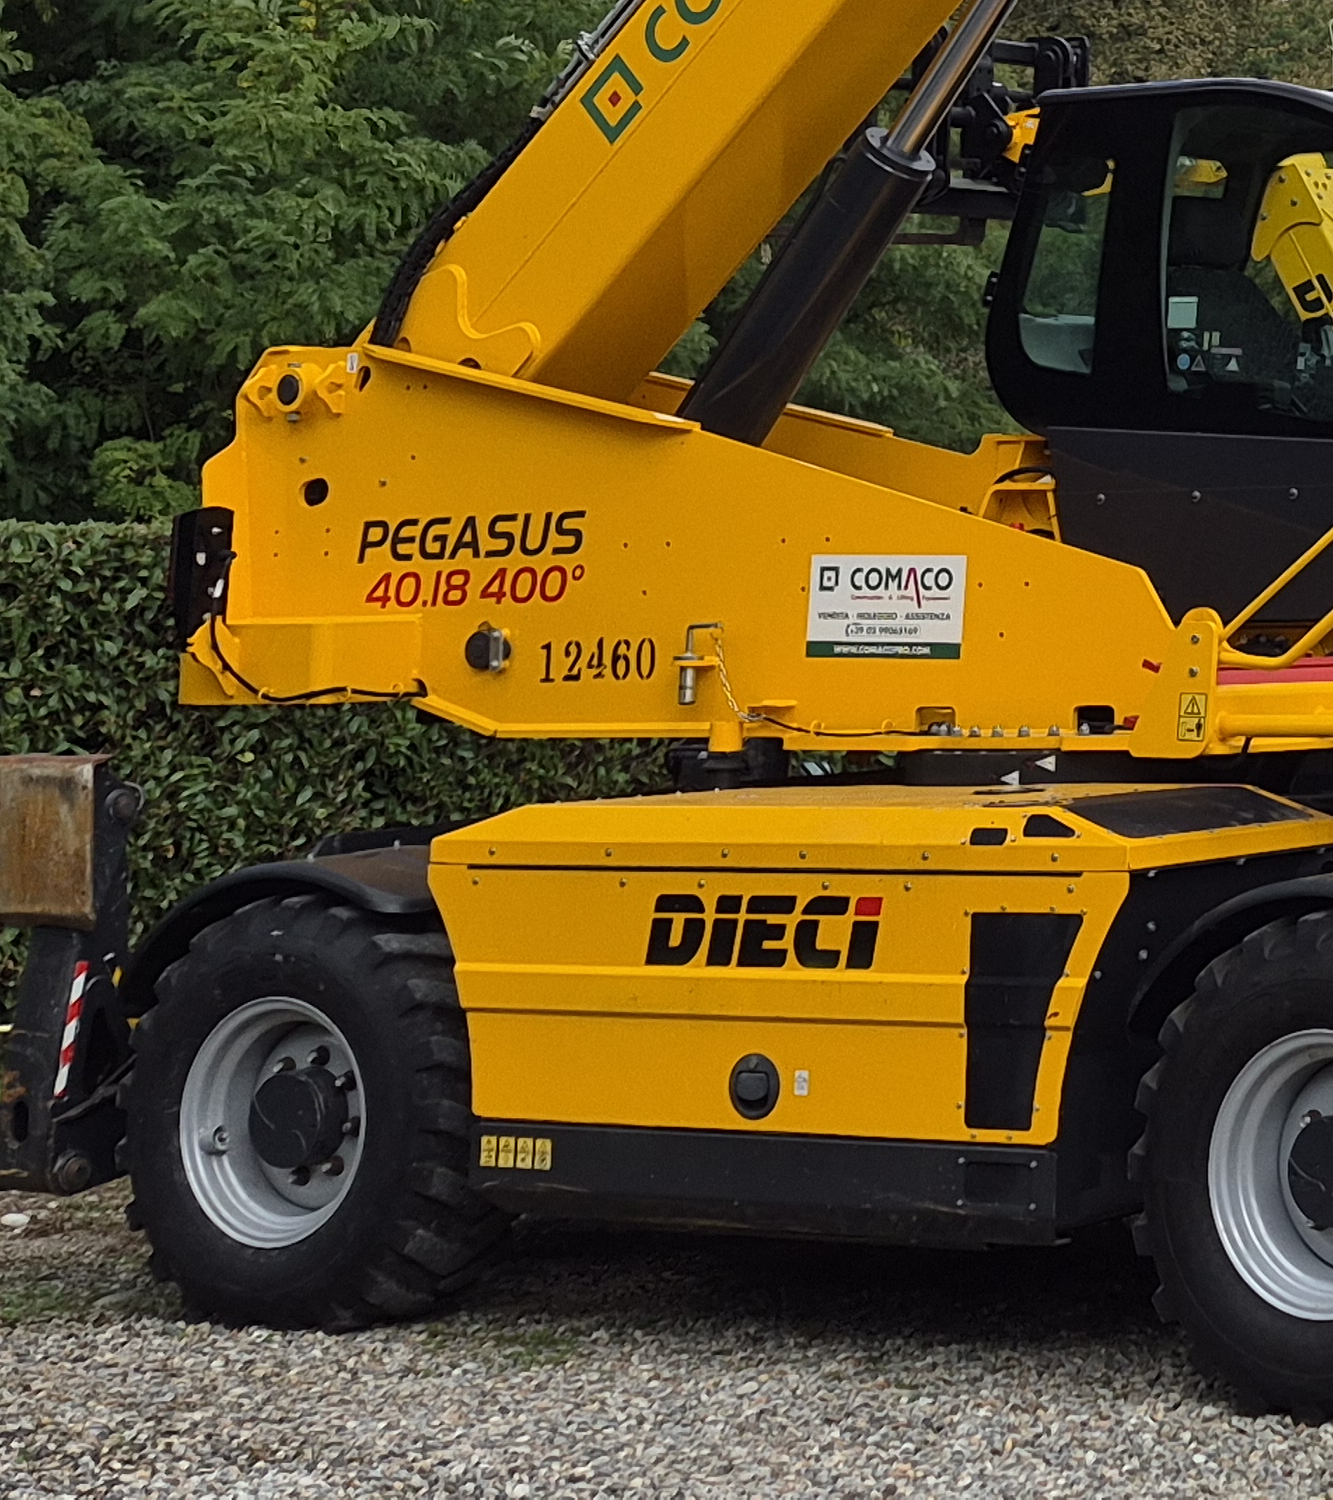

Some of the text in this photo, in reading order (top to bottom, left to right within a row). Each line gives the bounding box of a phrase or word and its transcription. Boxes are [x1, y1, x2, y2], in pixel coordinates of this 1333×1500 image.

[357, 510, 587, 564] PEGASUS
[364, 569, 471, 609] 40.18
[850, 567, 954, 609] COMACO
[539, 637, 656, 684] 12460
